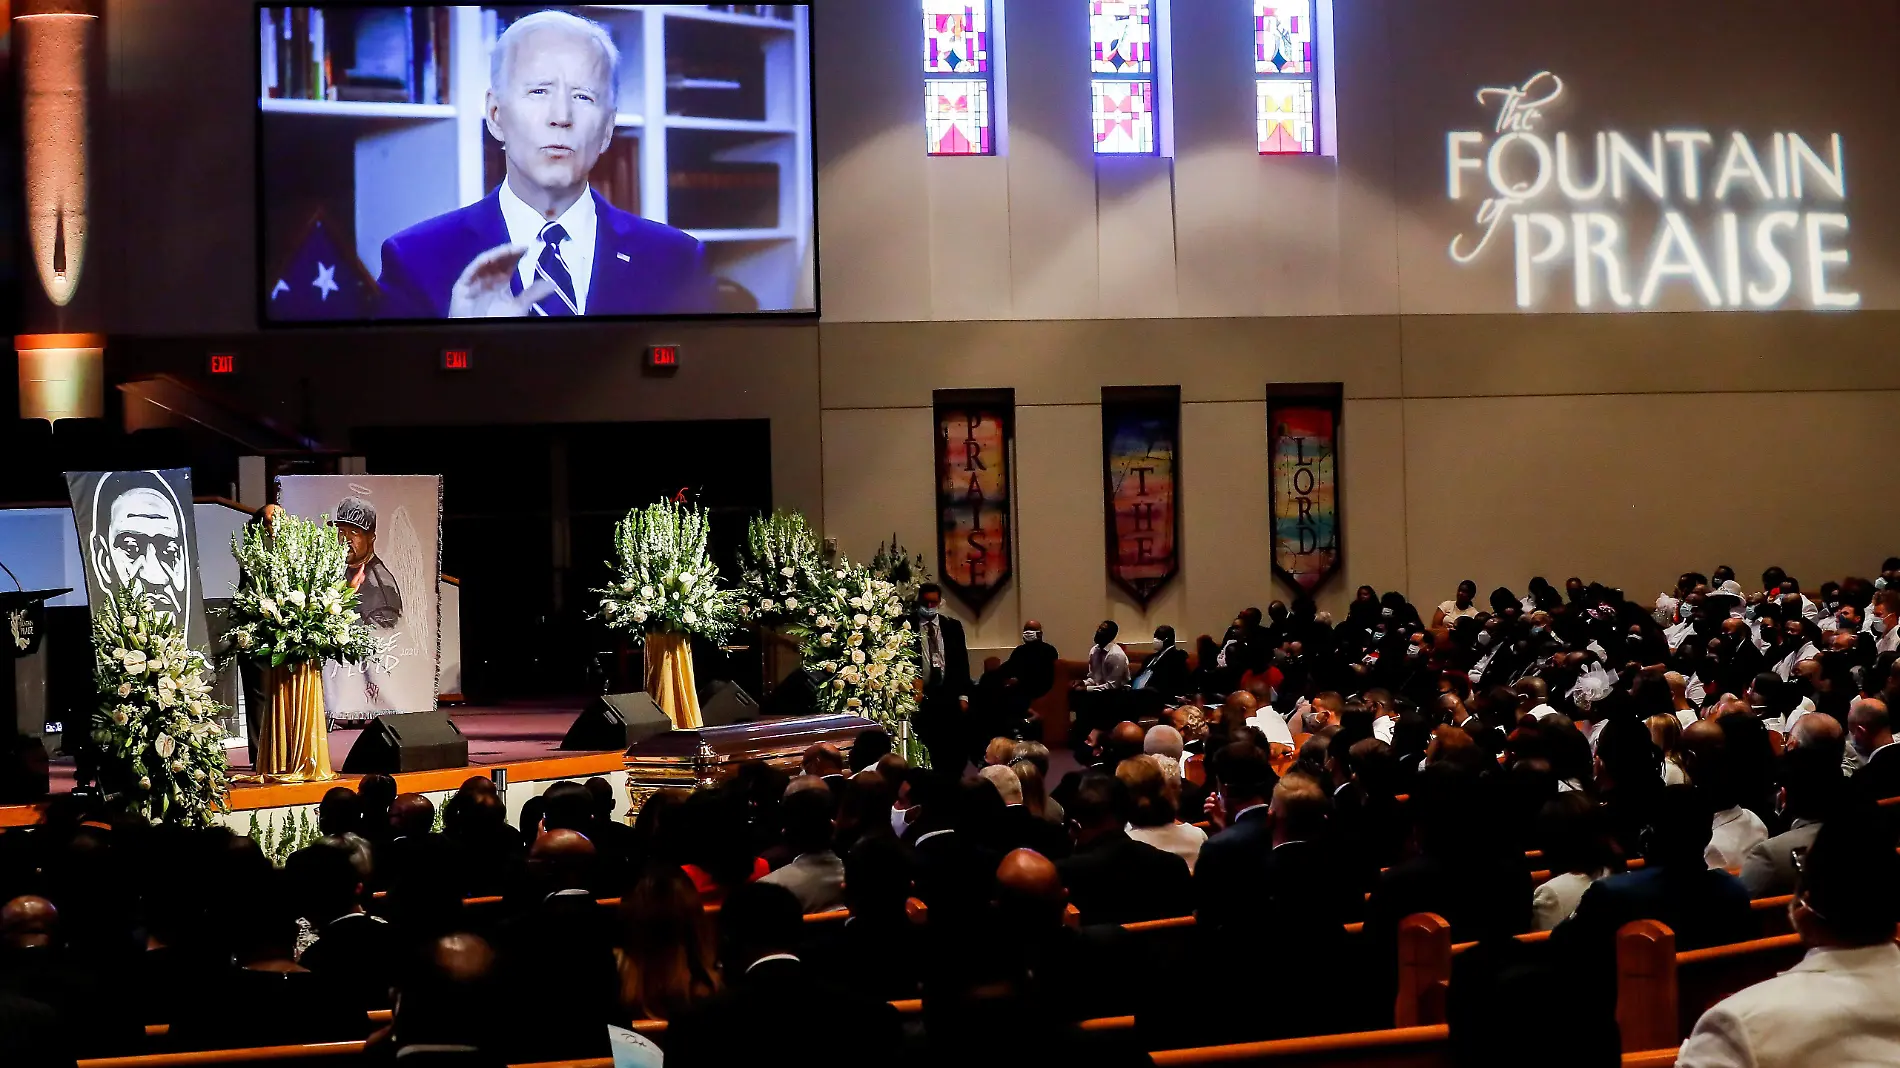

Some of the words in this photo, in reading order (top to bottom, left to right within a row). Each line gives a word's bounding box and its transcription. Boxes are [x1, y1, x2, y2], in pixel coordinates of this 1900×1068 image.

[1476, 71, 1563, 132] The
[1447, 131, 1846, 200] FOUNTAIN
[1512, 211, 1861, 308] PRAISE
[211, 354, 234, 373] EXIT
[446, 351, 467, 369] EXIT
[654, 347, 675, 365] EXIT
[963, 411, 988, 588] PRAISE
[1130, 467, 1154, 565] THE
[1293, 437, 1317, 555] LORD
